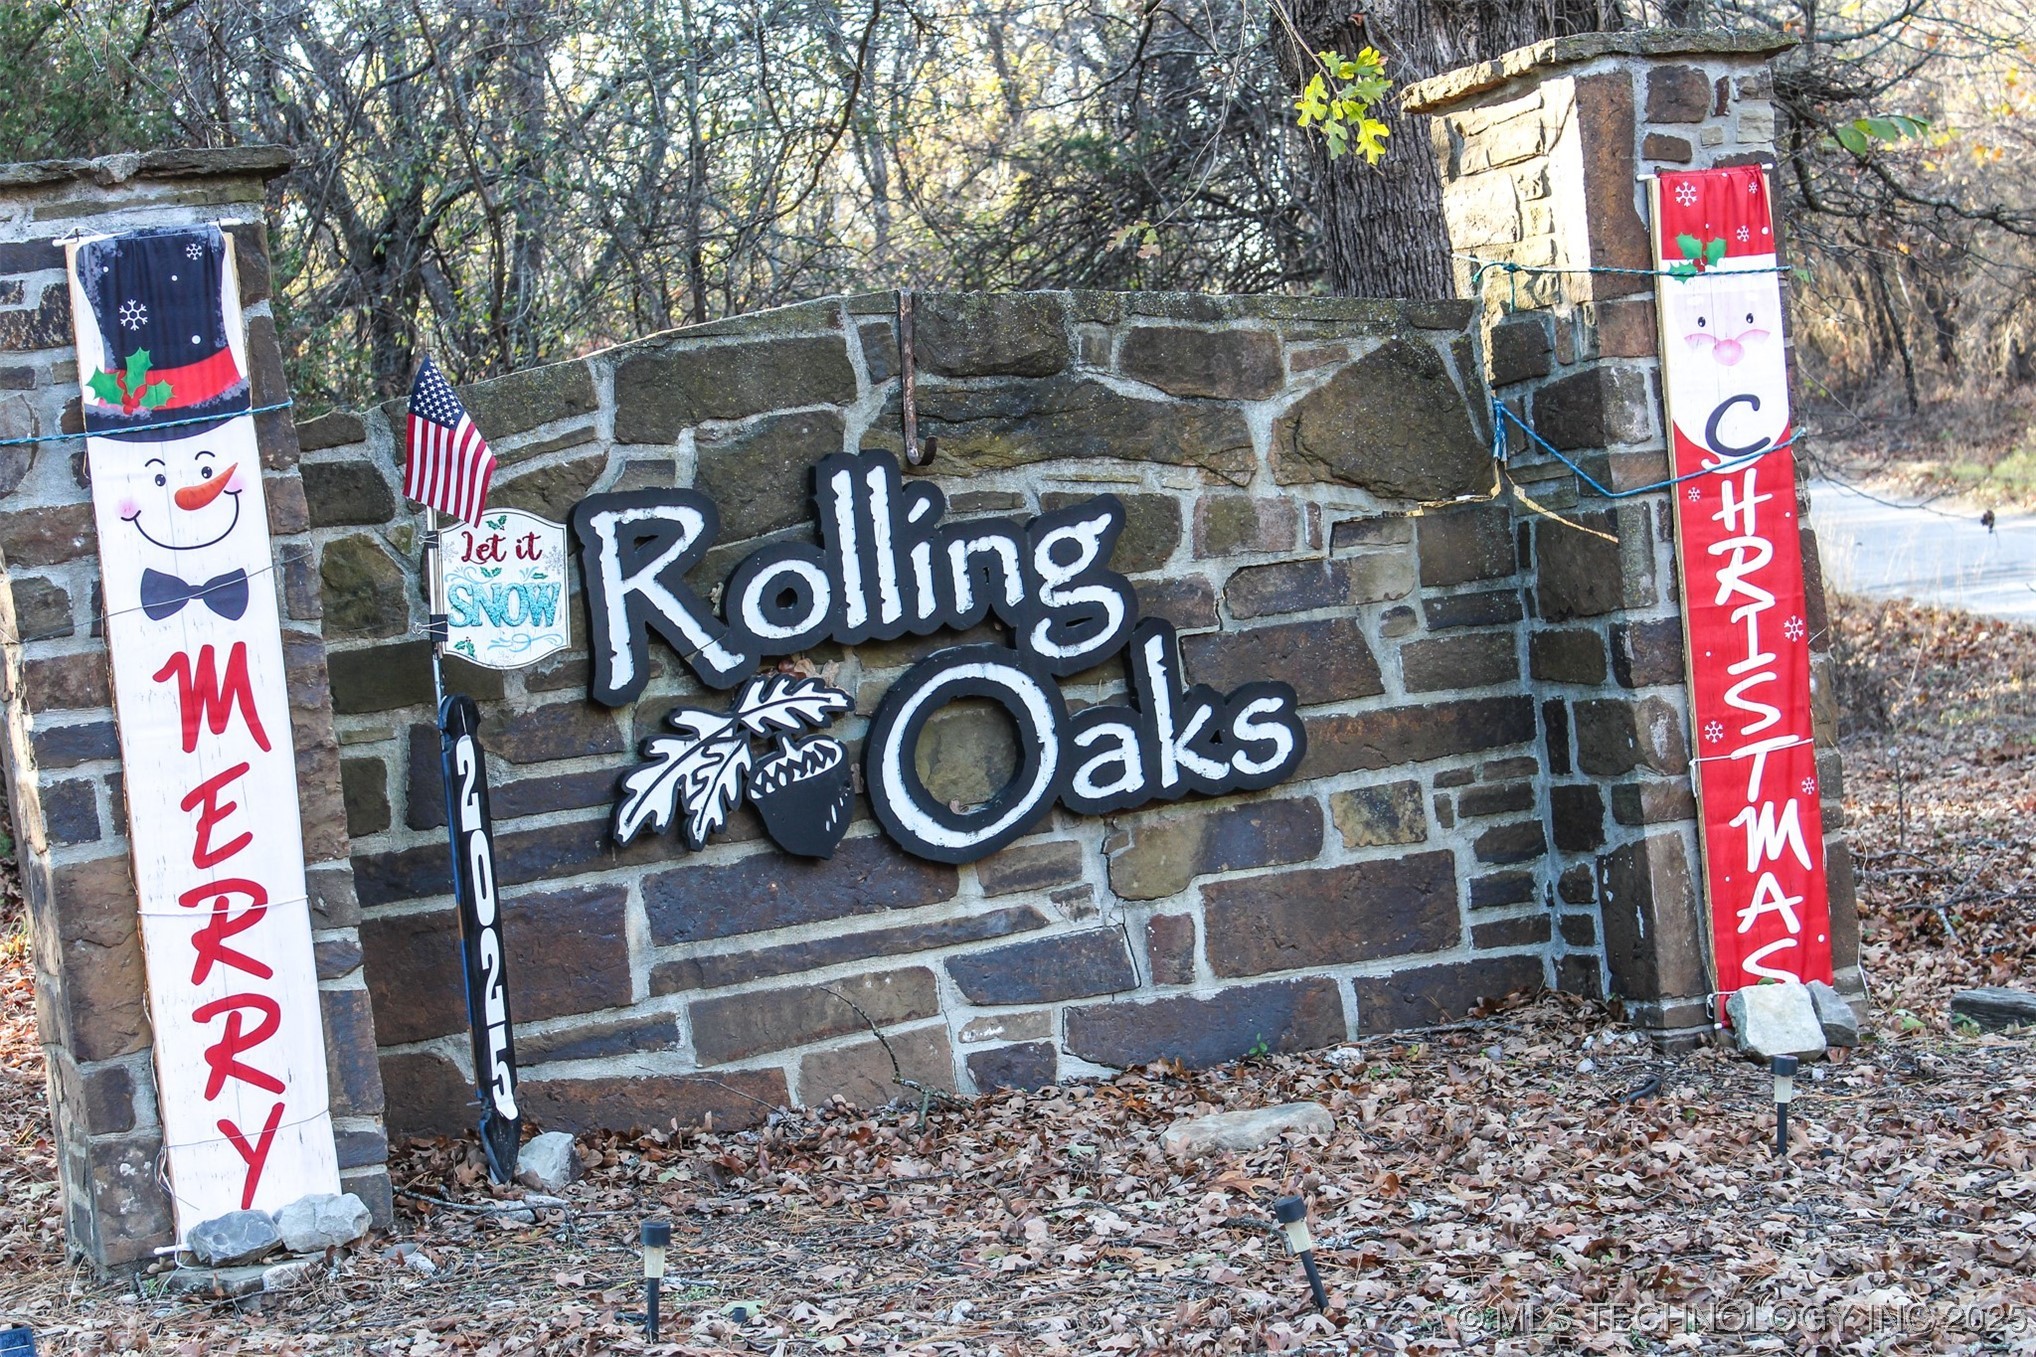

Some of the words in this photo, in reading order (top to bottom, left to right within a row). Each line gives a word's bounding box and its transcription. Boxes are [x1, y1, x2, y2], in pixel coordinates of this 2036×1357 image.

[448, 582, 561, 628] SNOW
[461, 531, 507, 564] Let
[515, 531, 543, 560] it
[590, 465, 1126, 692] Rolling
[882, 634, 1294, 850] Oaks
[1705, 394, 1812, 984] CHRISTMAS
[153, 641, 286, 1209] MERRY
[456, 734, 519, 1121] 2025
